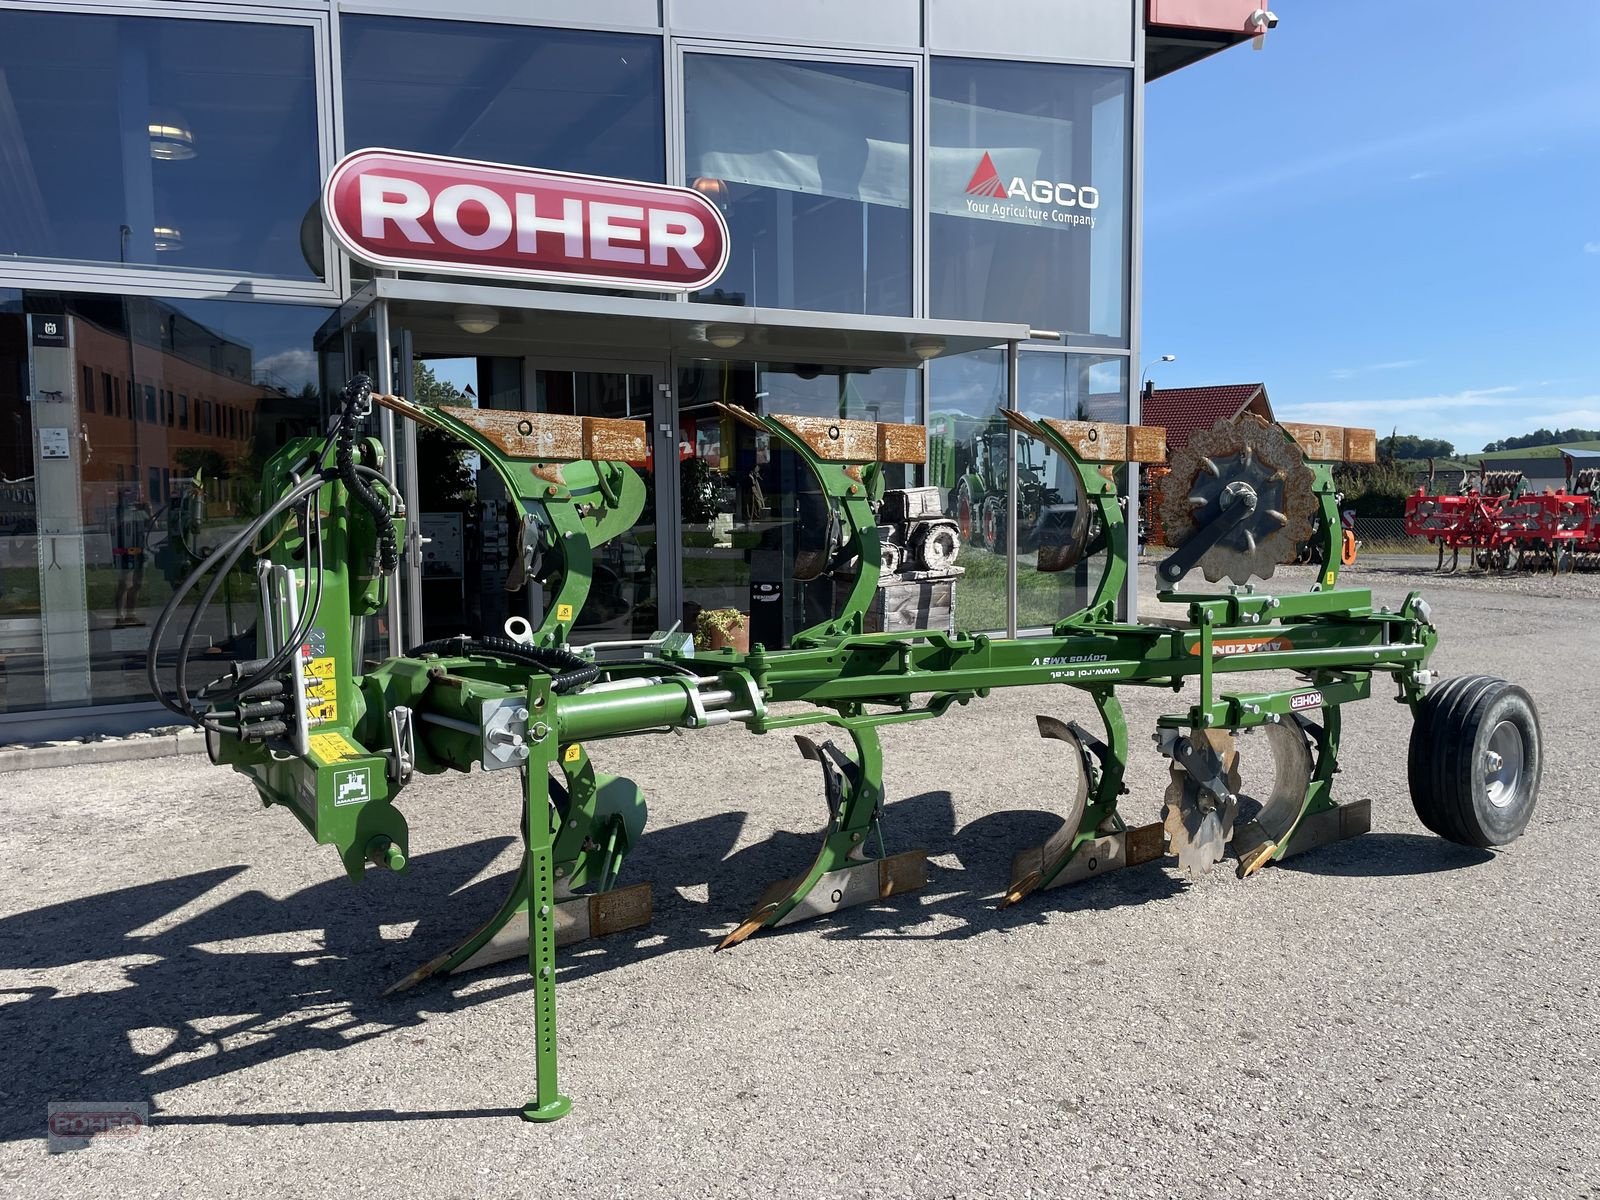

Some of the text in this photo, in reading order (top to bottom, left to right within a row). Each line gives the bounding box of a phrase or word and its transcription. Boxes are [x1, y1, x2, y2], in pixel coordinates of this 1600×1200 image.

[1007, 177, 1099, 209] AGCO
[359, 173, 708, 270] ROHER
[966, 199, 1097, 228] Your Agriculture Company
[1069, 653, 1108, 662] Cayros
[1212, 642, 1282, 655] AMAZON
[1291, 693, 1321, 708] ROHER
